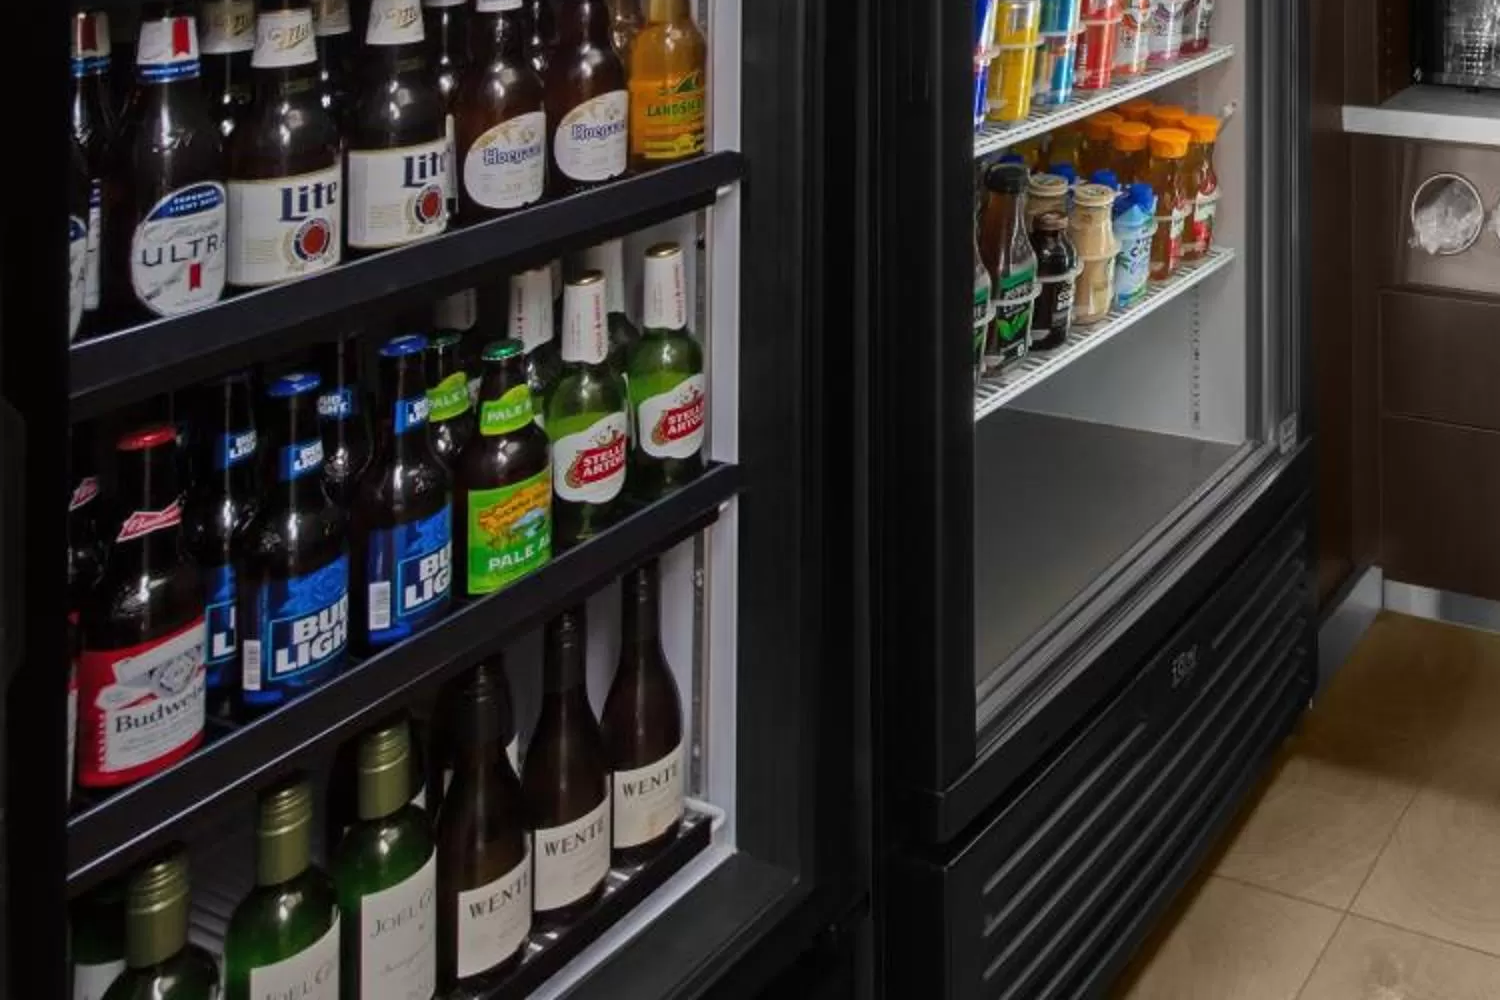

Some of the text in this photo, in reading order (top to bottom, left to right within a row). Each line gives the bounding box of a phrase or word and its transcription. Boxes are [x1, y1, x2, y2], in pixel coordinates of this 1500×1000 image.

[279, 180, 338, 223] Lite
[141, 233, 225, 267] ULTR
[667, 413, 705, 436] ARTO
[668, 401, 705, 426] STELL
[582, 454, 626, 478] ARTO
[419, 541, 452, 582] BU
[488, 542, 535, 573] PALE
[404, 572, 452, 610] LIG
[275, 622, 348, 674] LIGH
